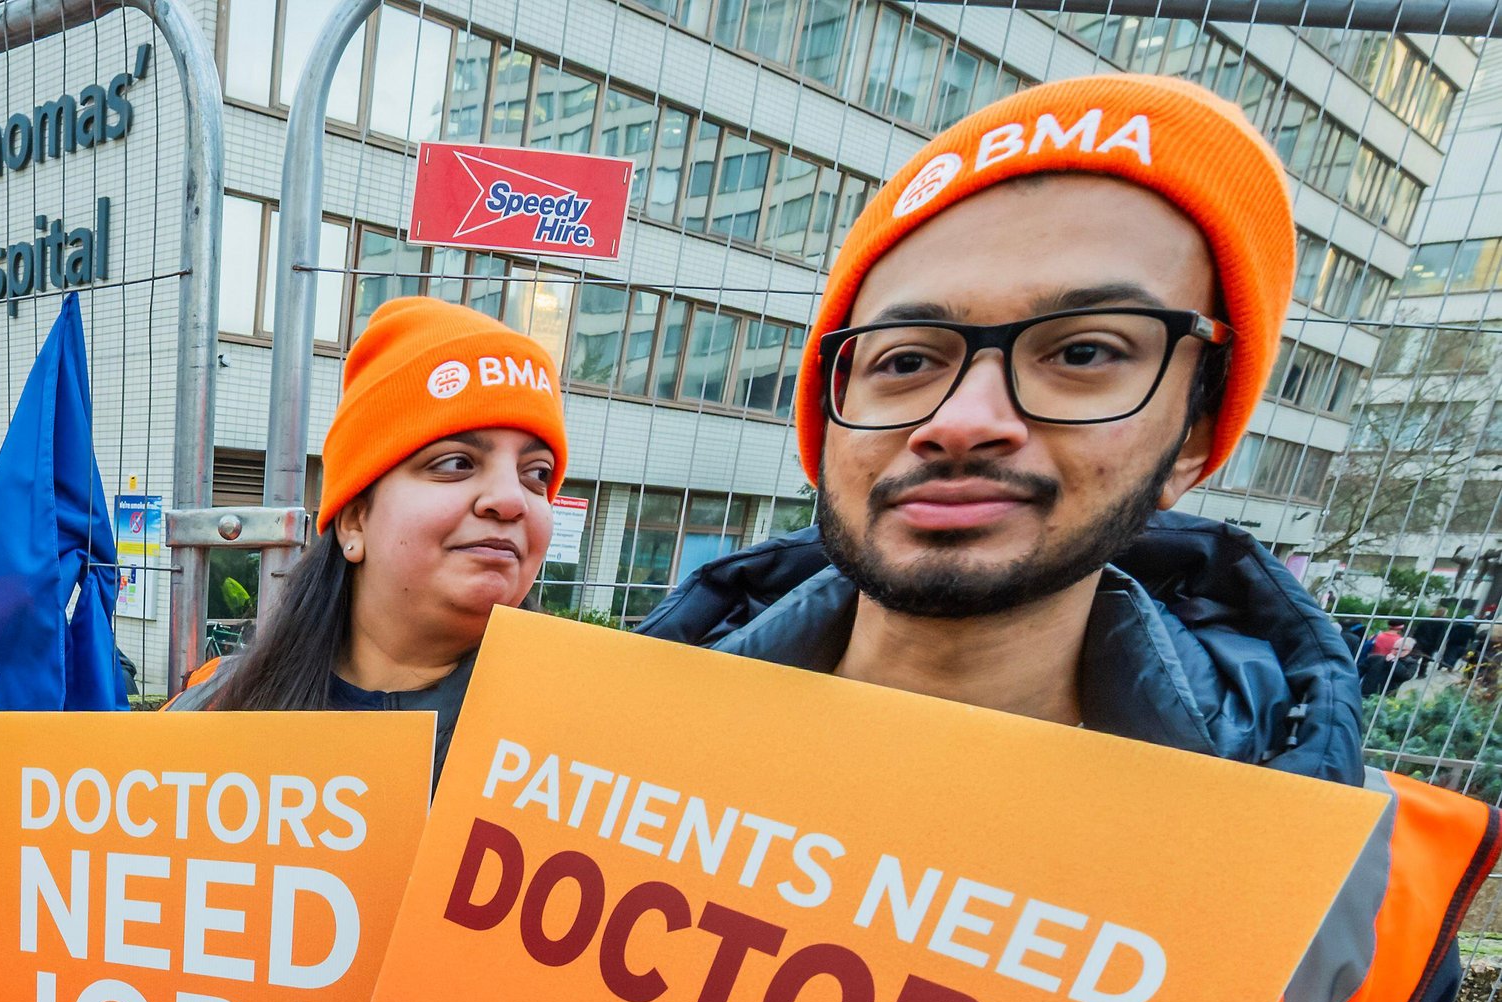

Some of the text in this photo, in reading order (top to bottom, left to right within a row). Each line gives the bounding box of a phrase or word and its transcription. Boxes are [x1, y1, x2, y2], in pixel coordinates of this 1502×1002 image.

[974, 108, 1152, 172] BMA
[486, 182, 591, 223] Speedy
[478, 356, 554, 397] BMA
[21, 766, 369, 851] DOCTORS
[481, 738, 846, 908] PATIENTS
[20, 846, 361, 989] NEED
